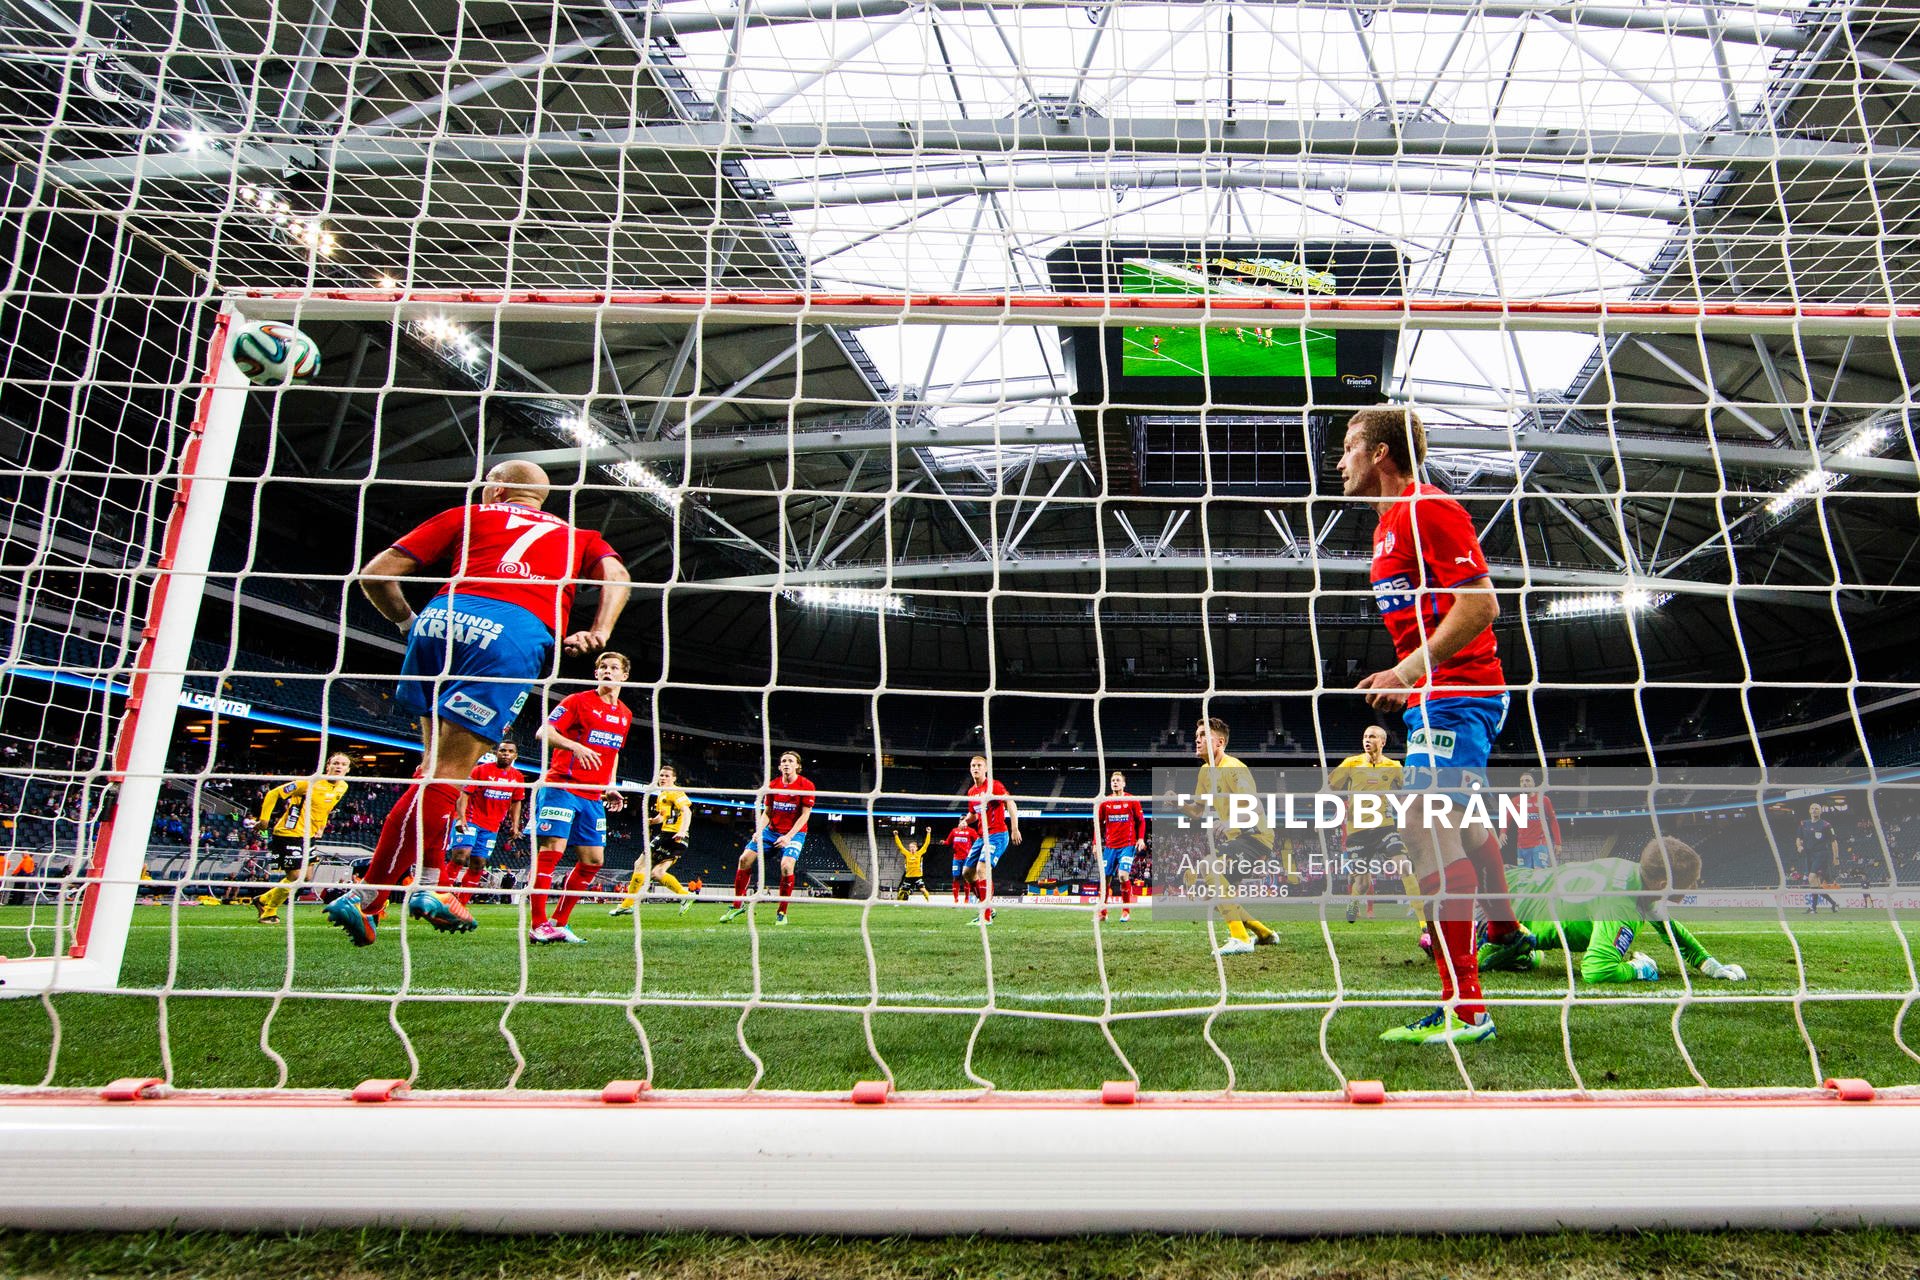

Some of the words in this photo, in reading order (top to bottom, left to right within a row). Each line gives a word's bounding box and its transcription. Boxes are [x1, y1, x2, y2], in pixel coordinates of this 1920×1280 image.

[1346, 377, 1372, 386] friends
[501, 513, 561, 562] 7
[413, 618, 499, 650] KRAFT
[464, 709, 485, 723] SPORT
[469, 703, 491, 717] INTER
[588, 737, 612, 747] BANK
[1411, 733, 1454, 748] OID
[1403, 766, 1416, 786] 21
[548, 808, 572, 818] SOLID
